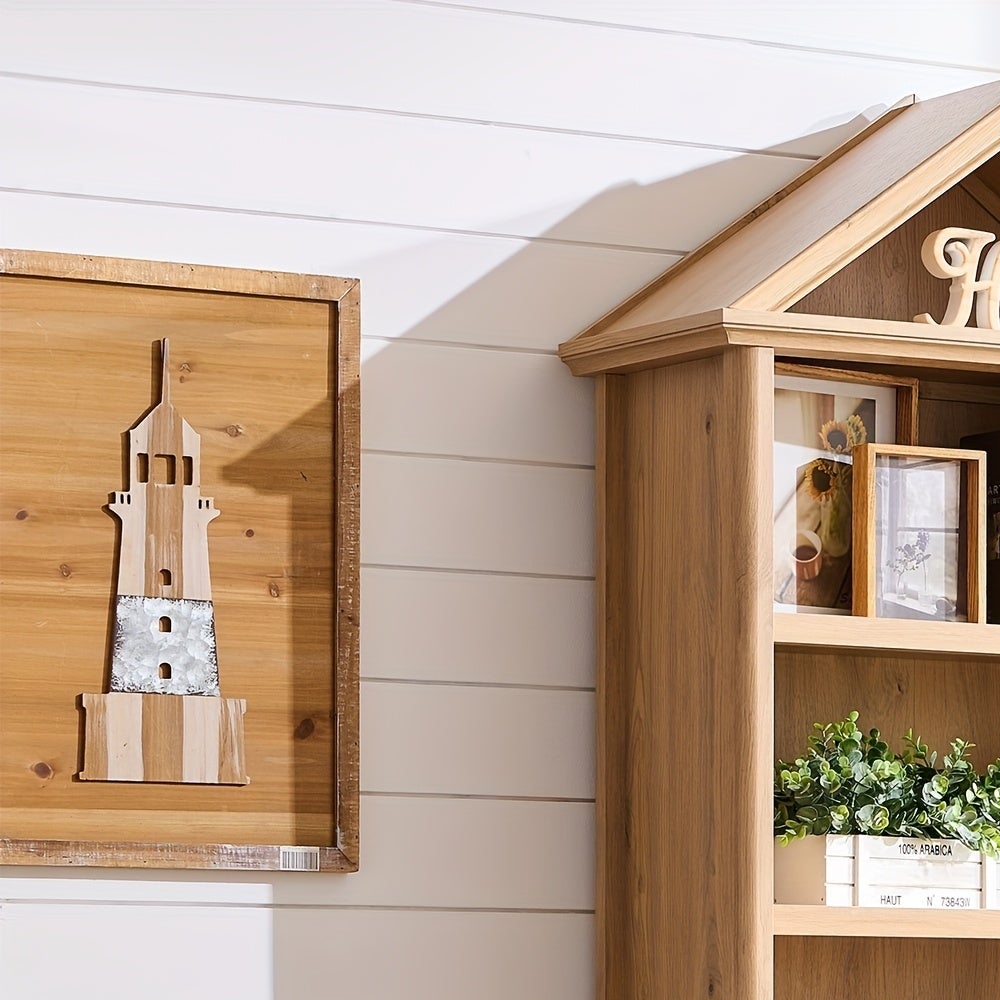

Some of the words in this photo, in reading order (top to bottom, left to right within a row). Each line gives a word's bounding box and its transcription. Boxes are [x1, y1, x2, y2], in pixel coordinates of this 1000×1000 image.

[899, 844, 918, 855] 100%
[920, 845, 952, 856] ARABICA
[881, 895, 901, 905] HAUT
